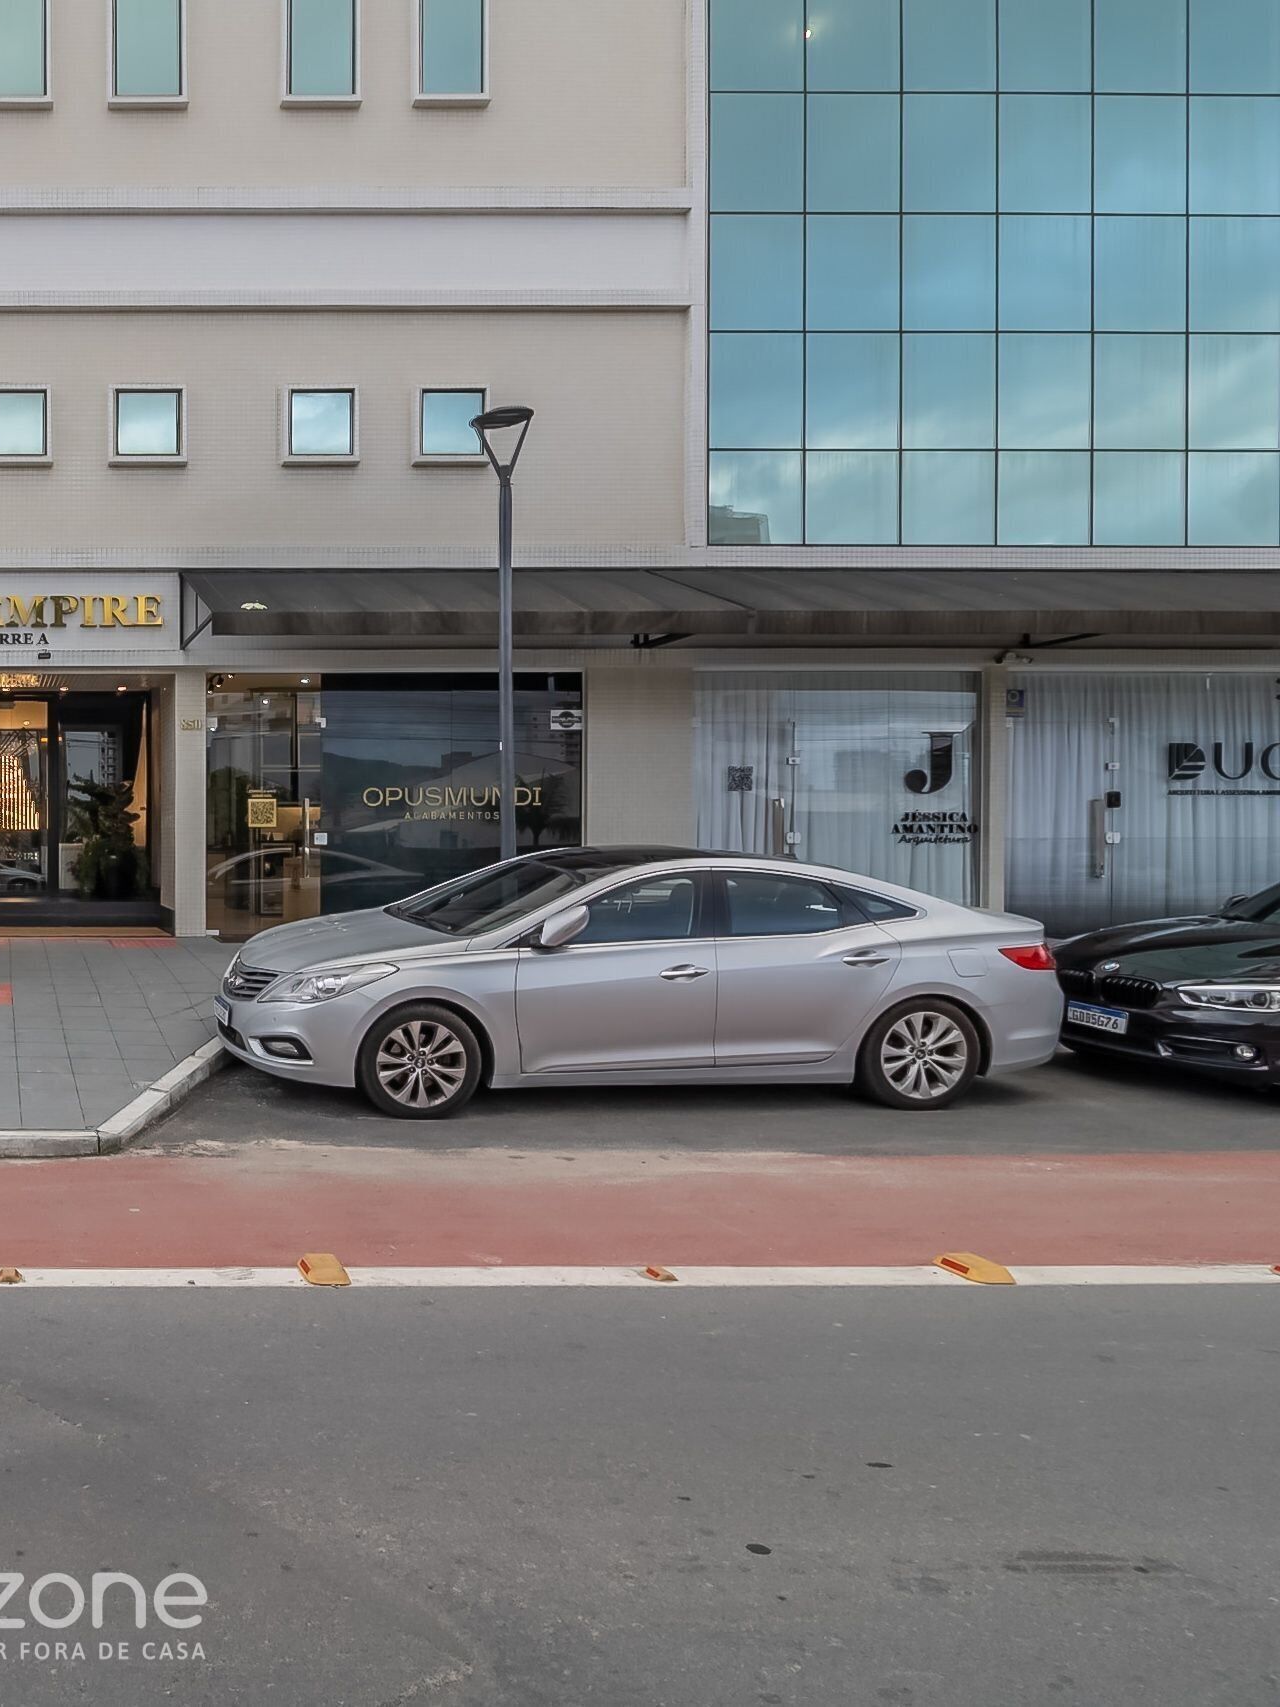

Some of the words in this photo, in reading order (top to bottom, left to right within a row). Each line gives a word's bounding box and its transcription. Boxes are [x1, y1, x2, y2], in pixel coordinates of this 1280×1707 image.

[36, 632, 50, 646] A
[901, 809, 968, 823] JÉSSICA
[891, 823, 979, 834] AMANTINO
